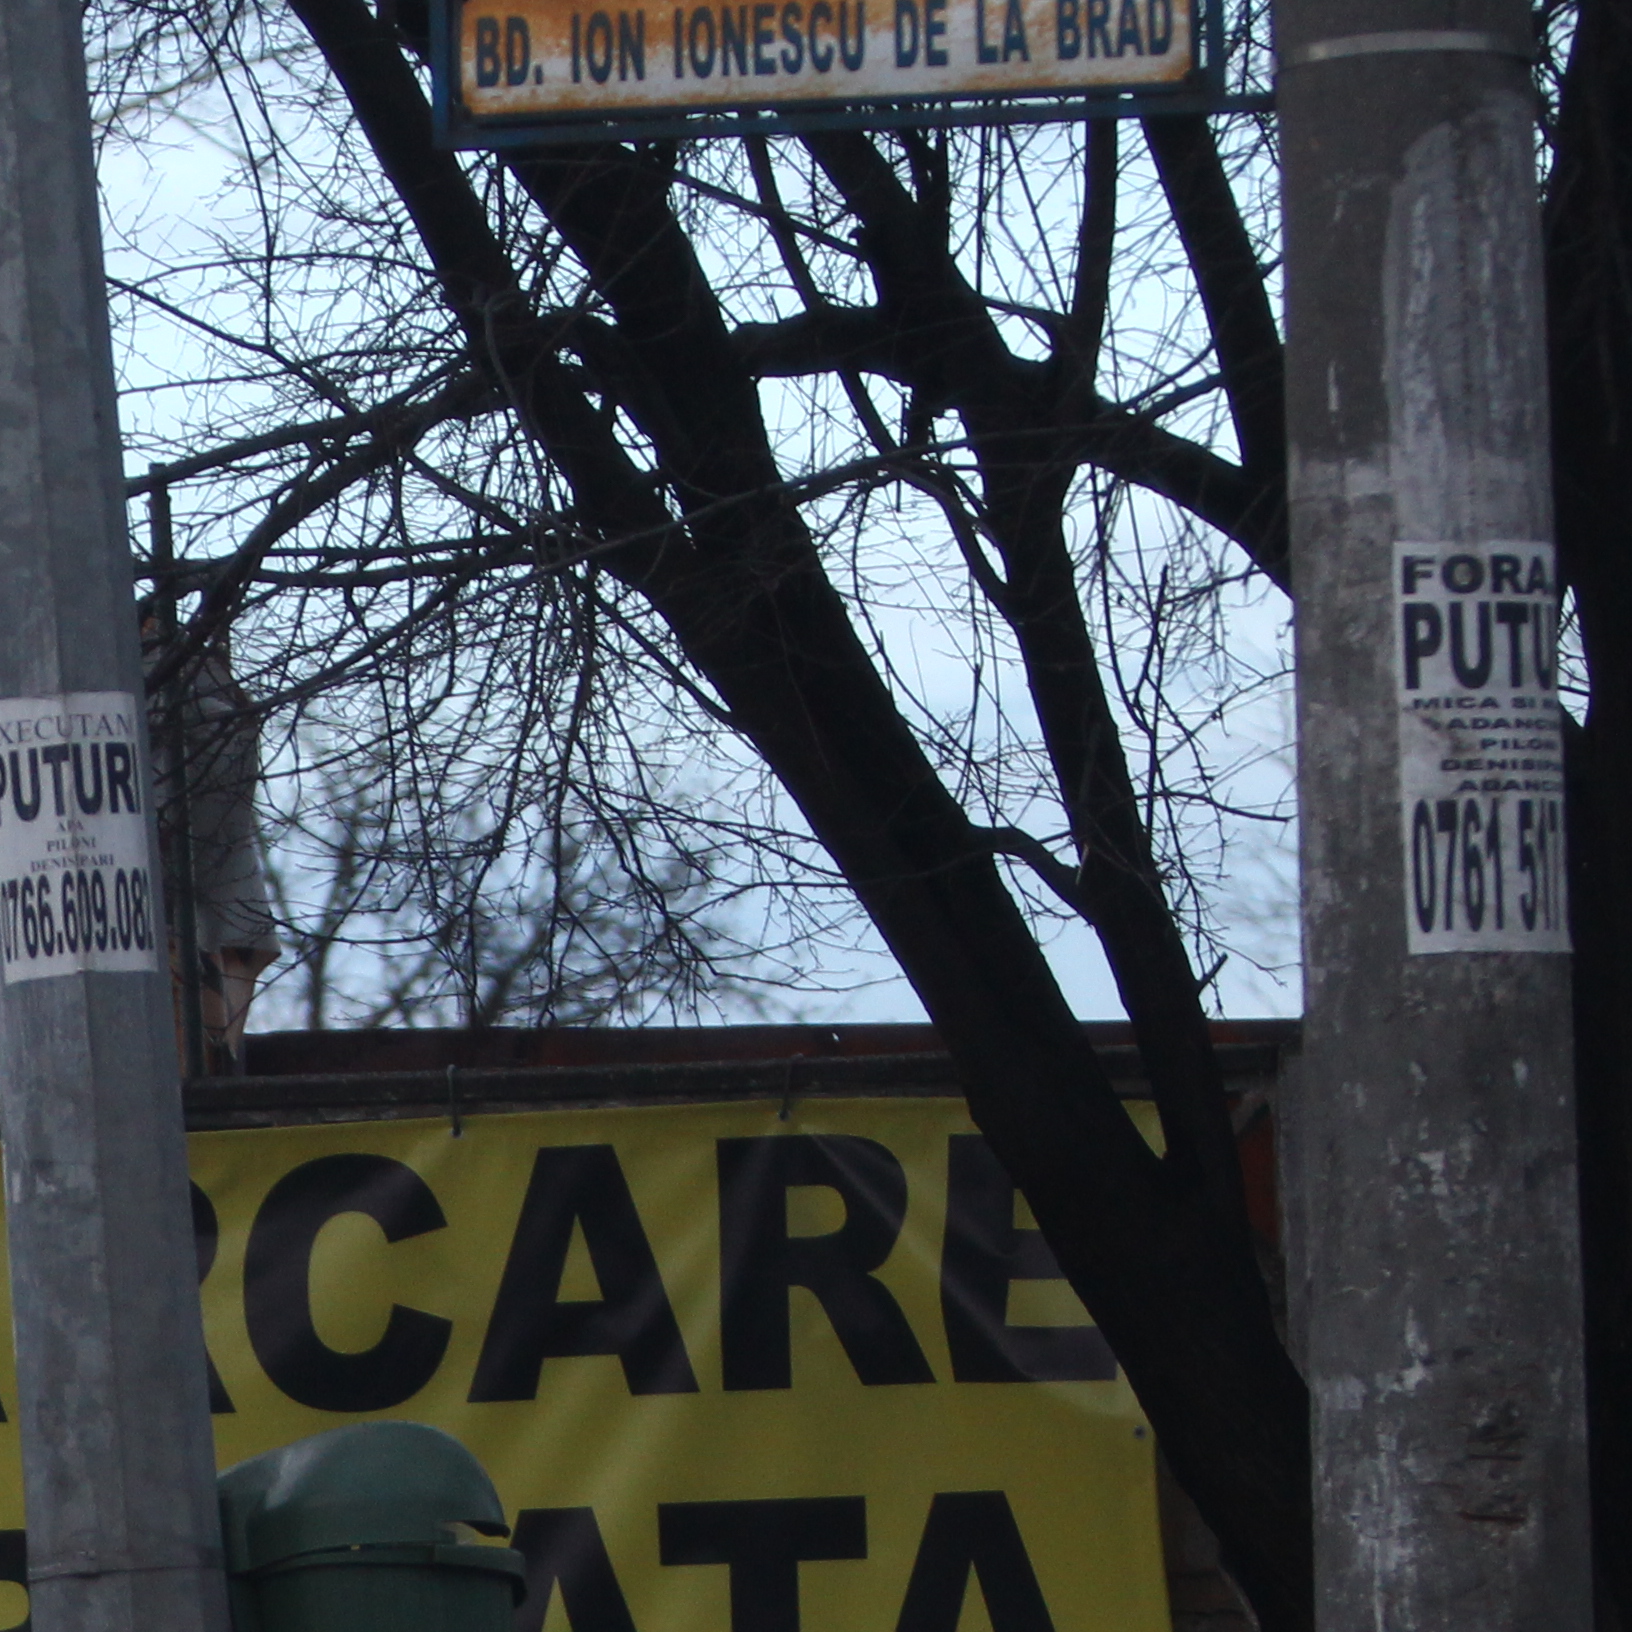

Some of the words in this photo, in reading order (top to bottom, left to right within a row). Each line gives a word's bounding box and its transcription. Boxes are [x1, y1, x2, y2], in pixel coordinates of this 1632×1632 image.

[477, 15, 544, 88] BD.
[572, 9, 646, 84] ION
[674, 0, 865, 80] IONESCU
[895, 0, 949, 69] DE
[977, 0, 1031, 64] LA
[1057, 0, 1172, 61] BRAD
[1413, 798, 1504, 933] 0761
